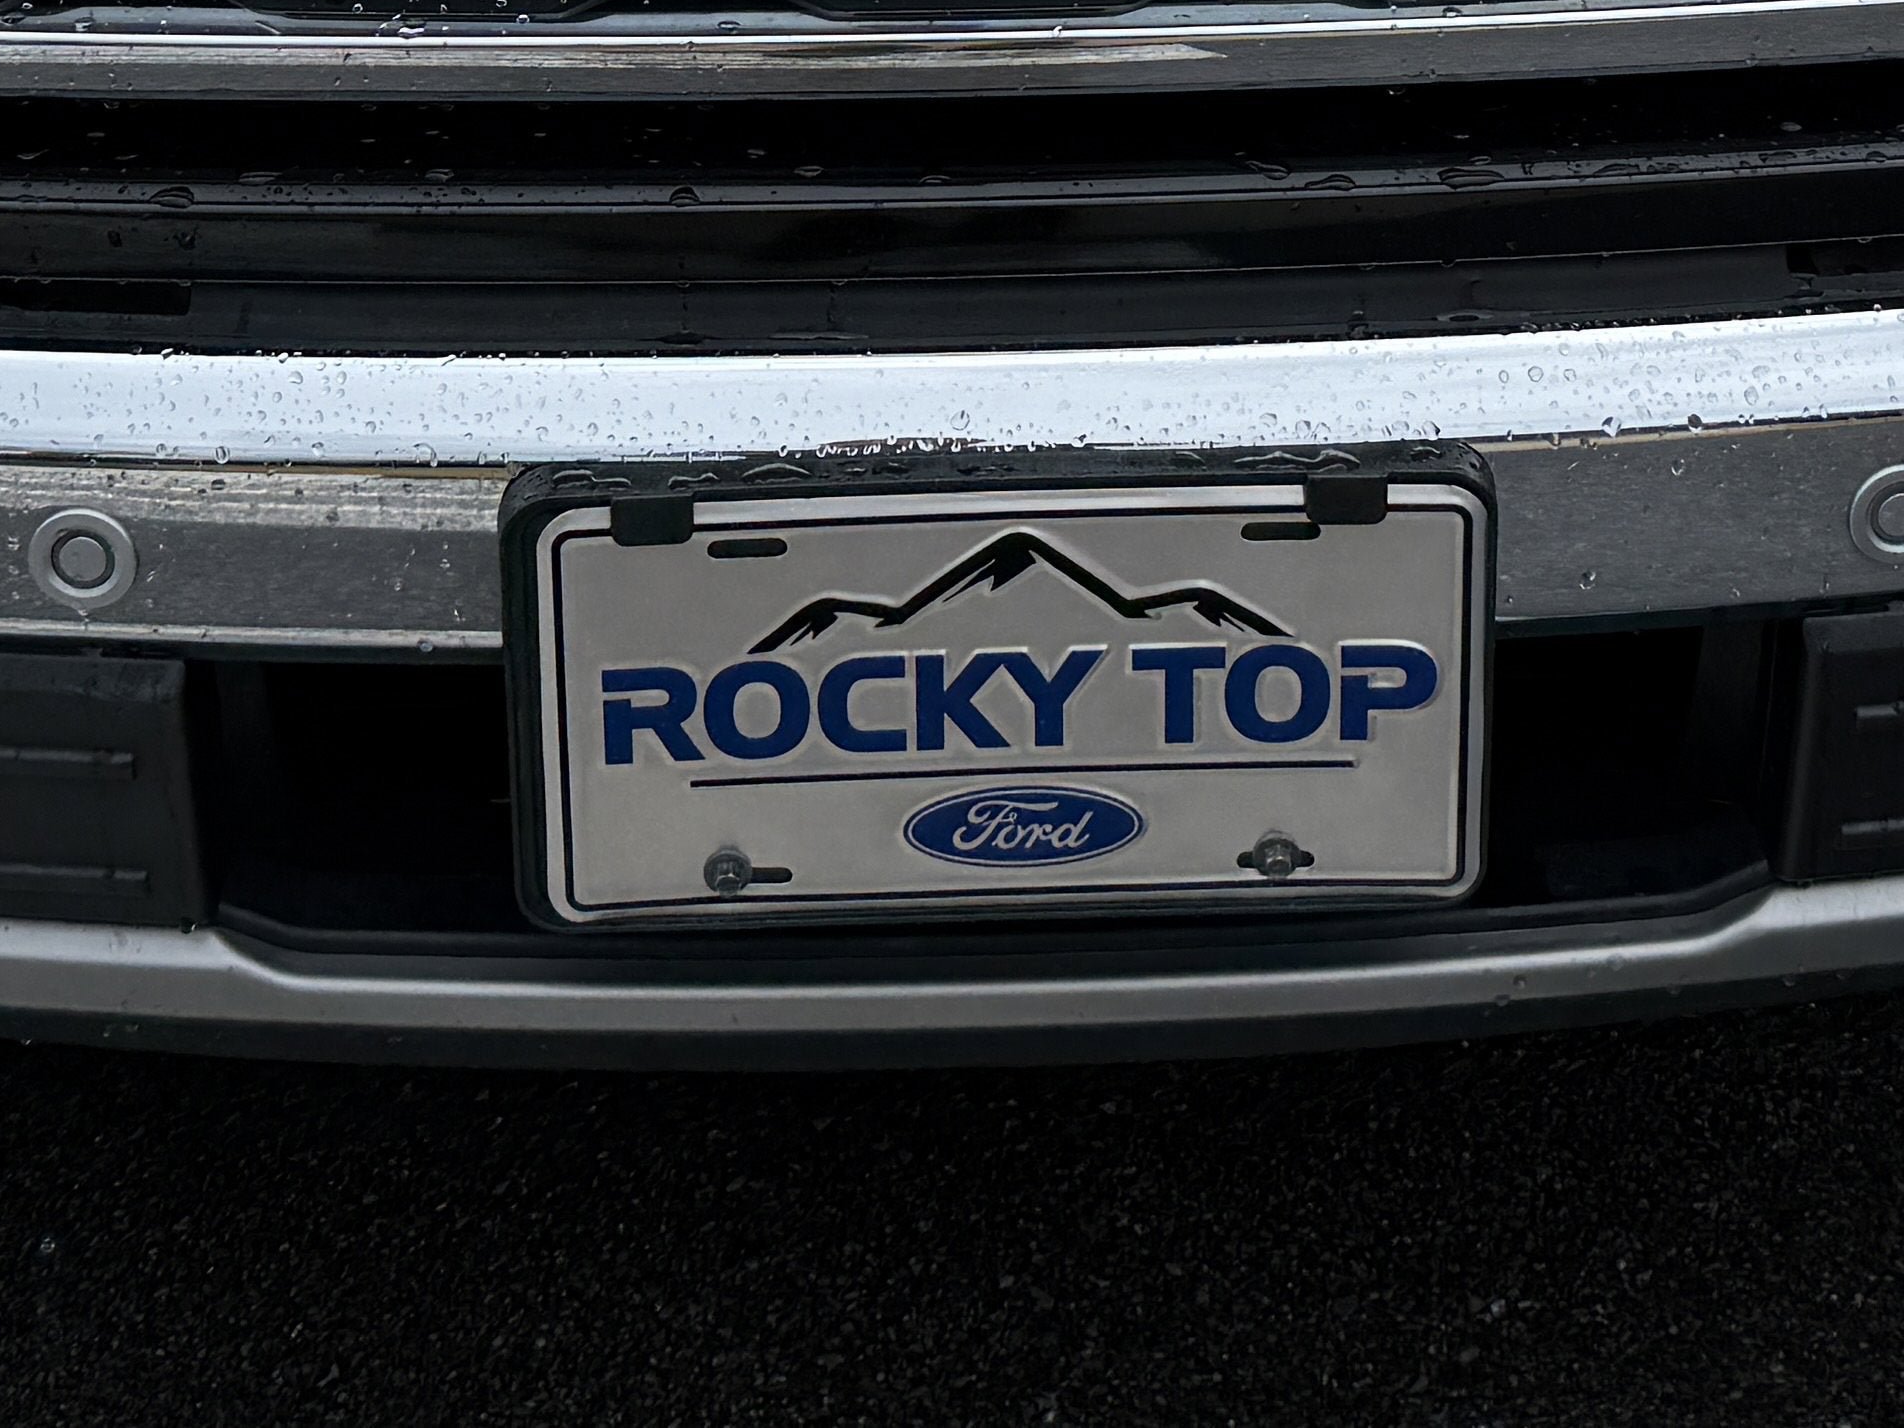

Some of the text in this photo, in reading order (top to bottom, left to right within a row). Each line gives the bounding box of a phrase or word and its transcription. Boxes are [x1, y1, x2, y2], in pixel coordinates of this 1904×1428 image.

[600, 643, 1438, 765] ROCKY TOP
[951, 802, 1094, 852] Ford
